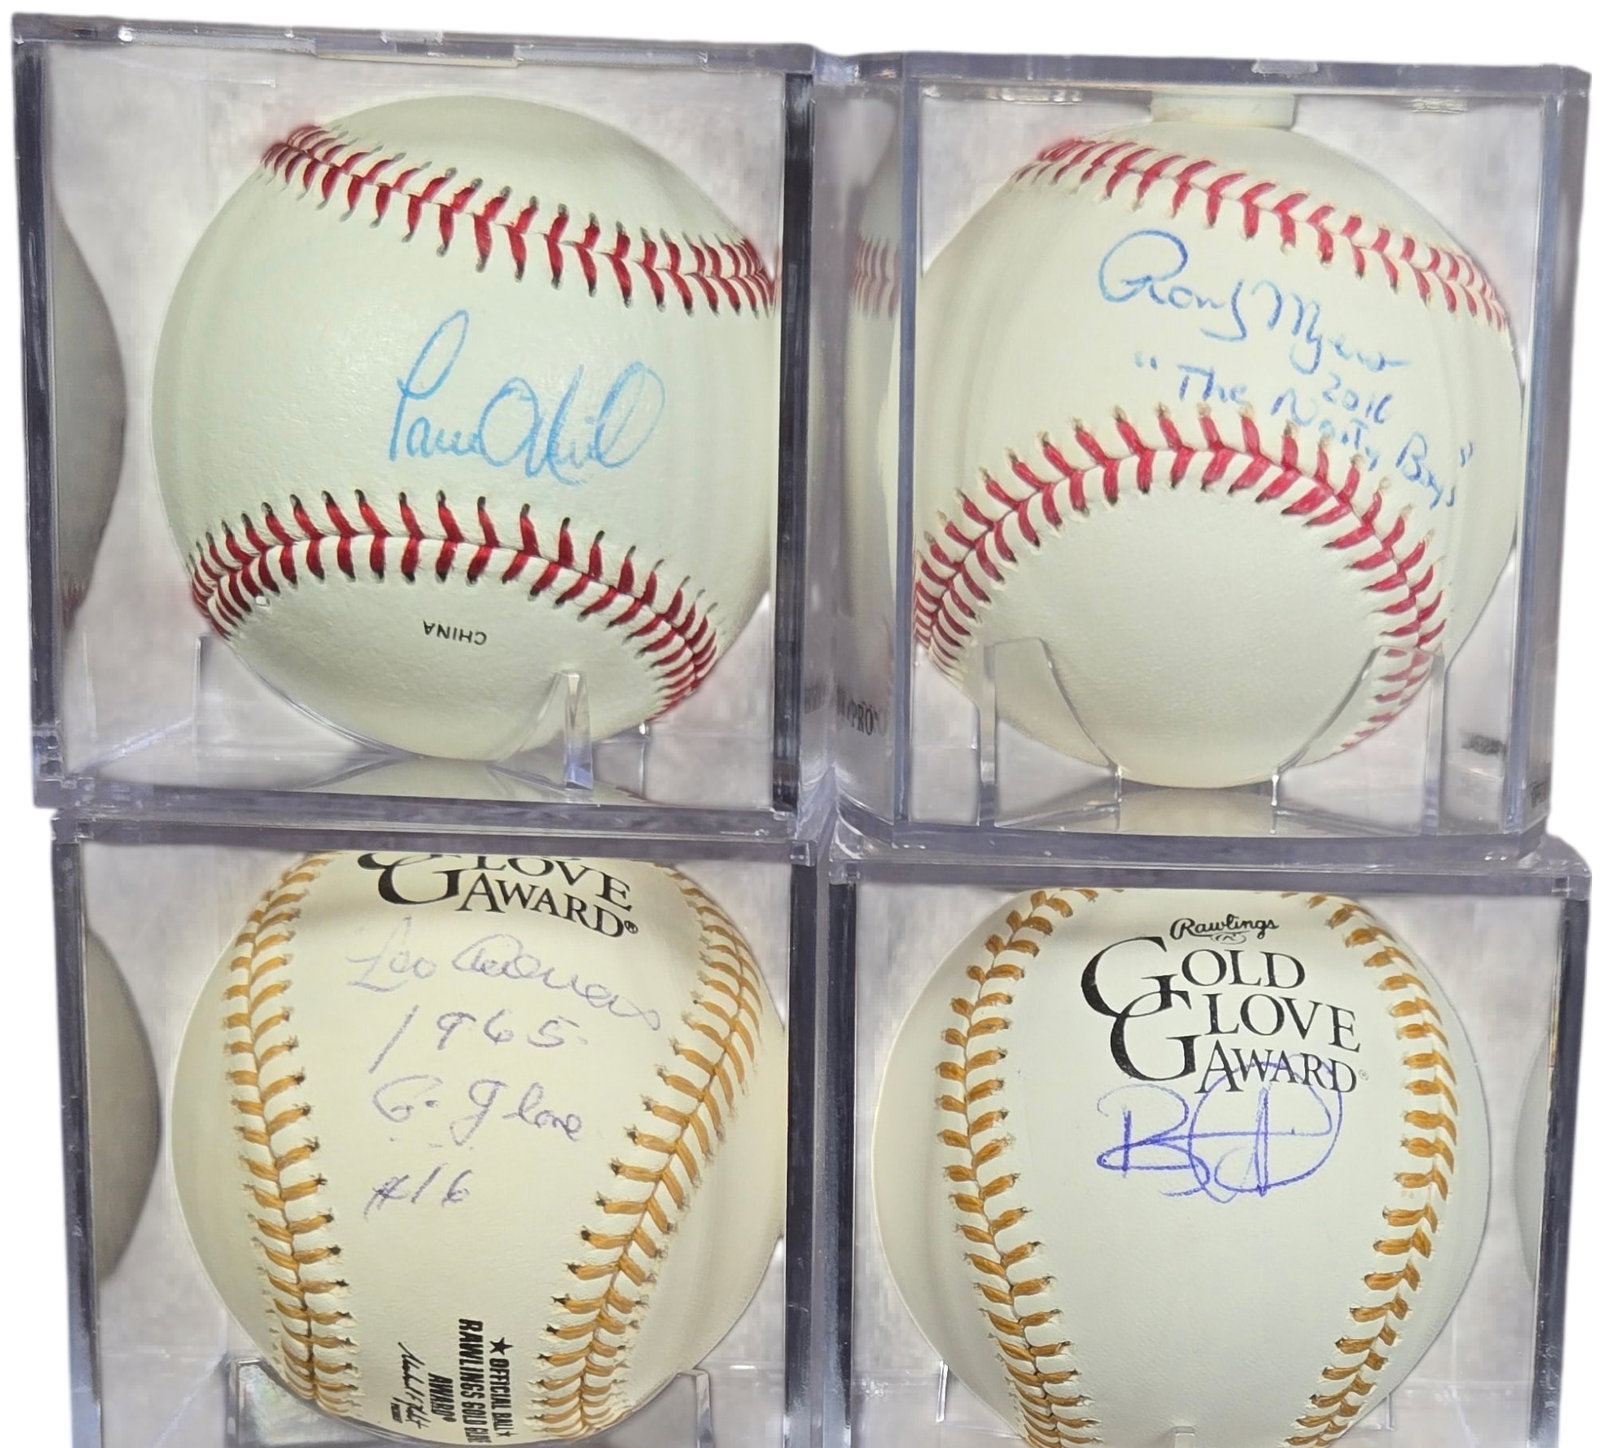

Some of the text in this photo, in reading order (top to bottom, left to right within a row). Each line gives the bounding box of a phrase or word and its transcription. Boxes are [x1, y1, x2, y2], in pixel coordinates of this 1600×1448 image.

[422, 620, 488, 646] CHINA
[1169, 913, 1280, 941] Rawlings
[1080, 936, 1306, 1019] GOLD
[1109, 988, 1361, 1082] GLOVE
[458, 1318, 486, 1399] RAWLINGS
[489, 1358, 515, 1431] OFFICIAL BALL
[461, 1401, 488, 1425] GOLD
